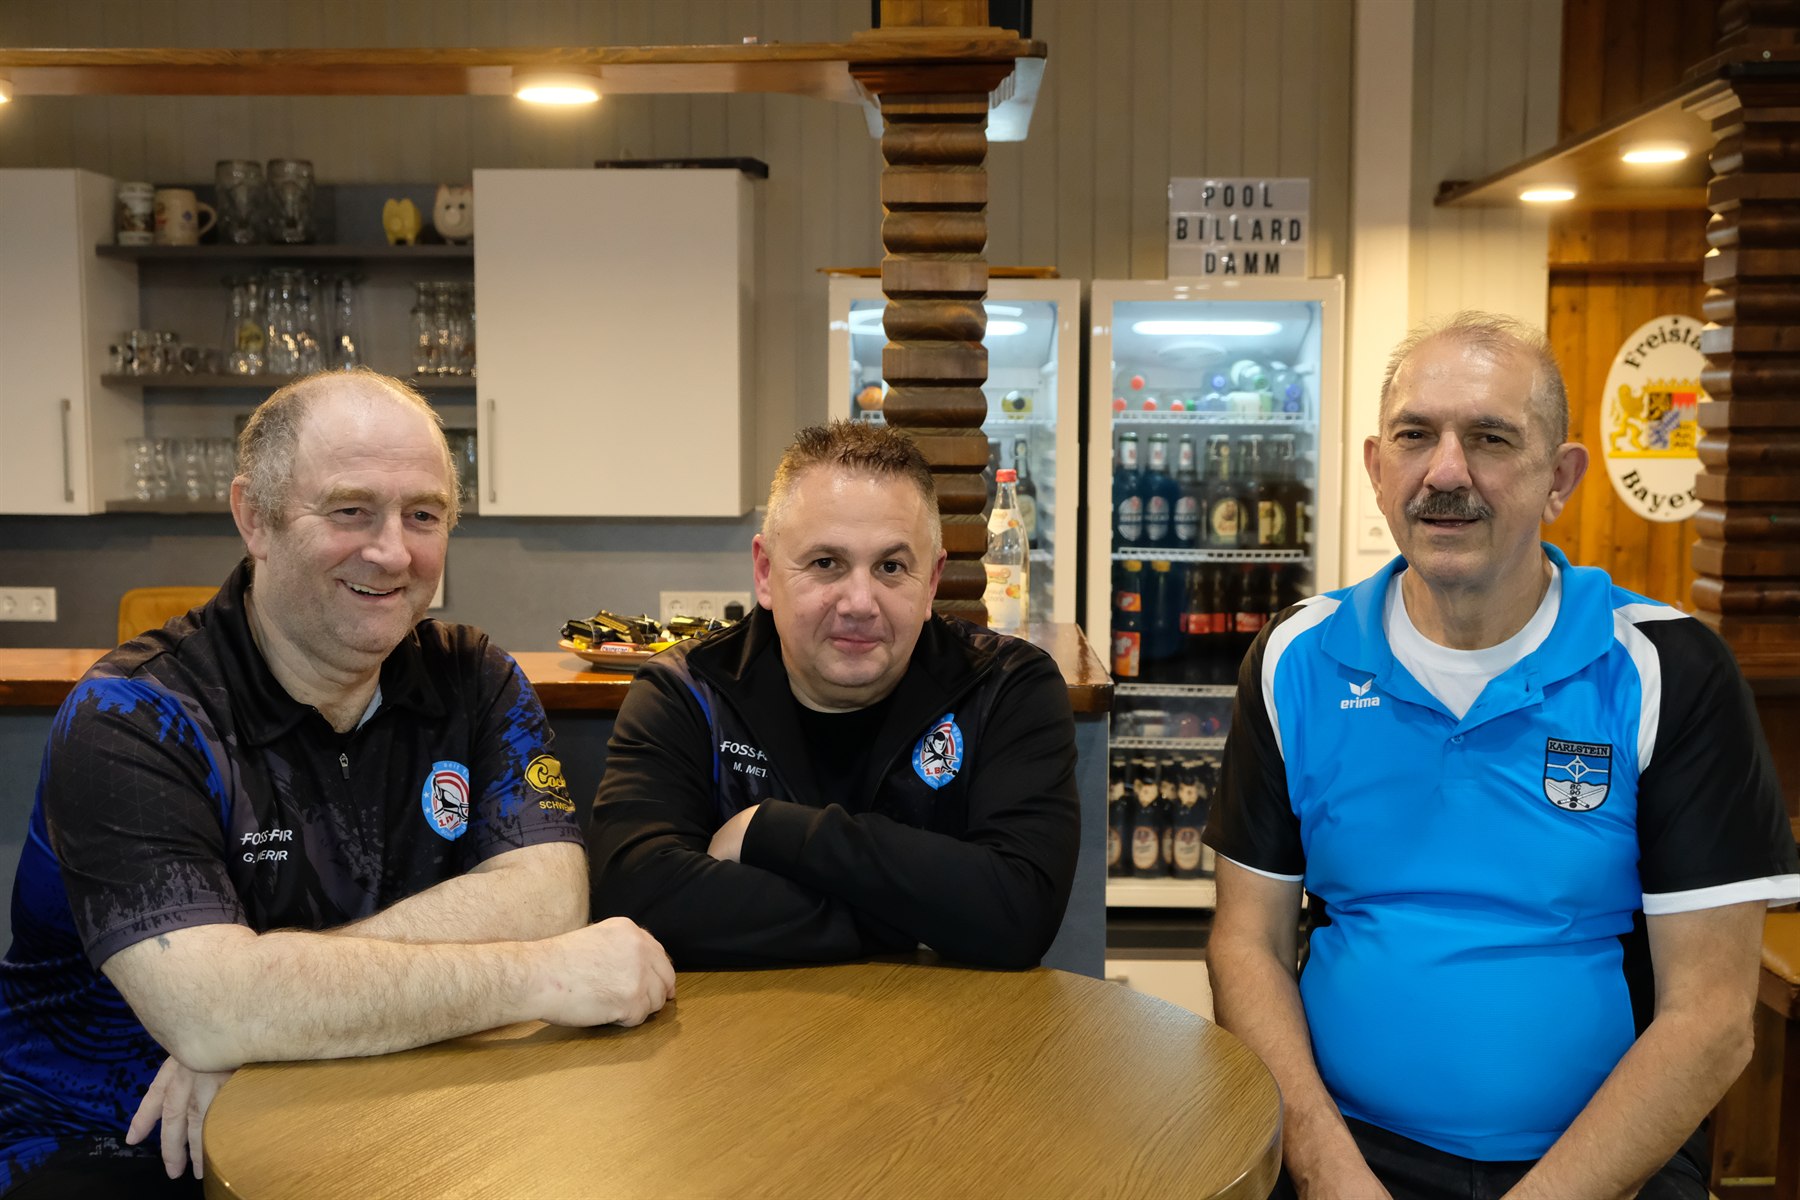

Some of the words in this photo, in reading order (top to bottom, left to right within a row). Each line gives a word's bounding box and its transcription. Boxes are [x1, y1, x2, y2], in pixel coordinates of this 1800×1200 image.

[1203, 185, 1274, 208] POOL
[1175, 217, 1302, 241] BILLARD
[1204, 252, 1281, 275] DAMM
[1623, 325, 1701, 370] Freista
[1622, 470, 1699, 513] Bayer
[1340, 696, 1380, 709] erima
[1549, 741, 1608, 755] KARLSTEIN
